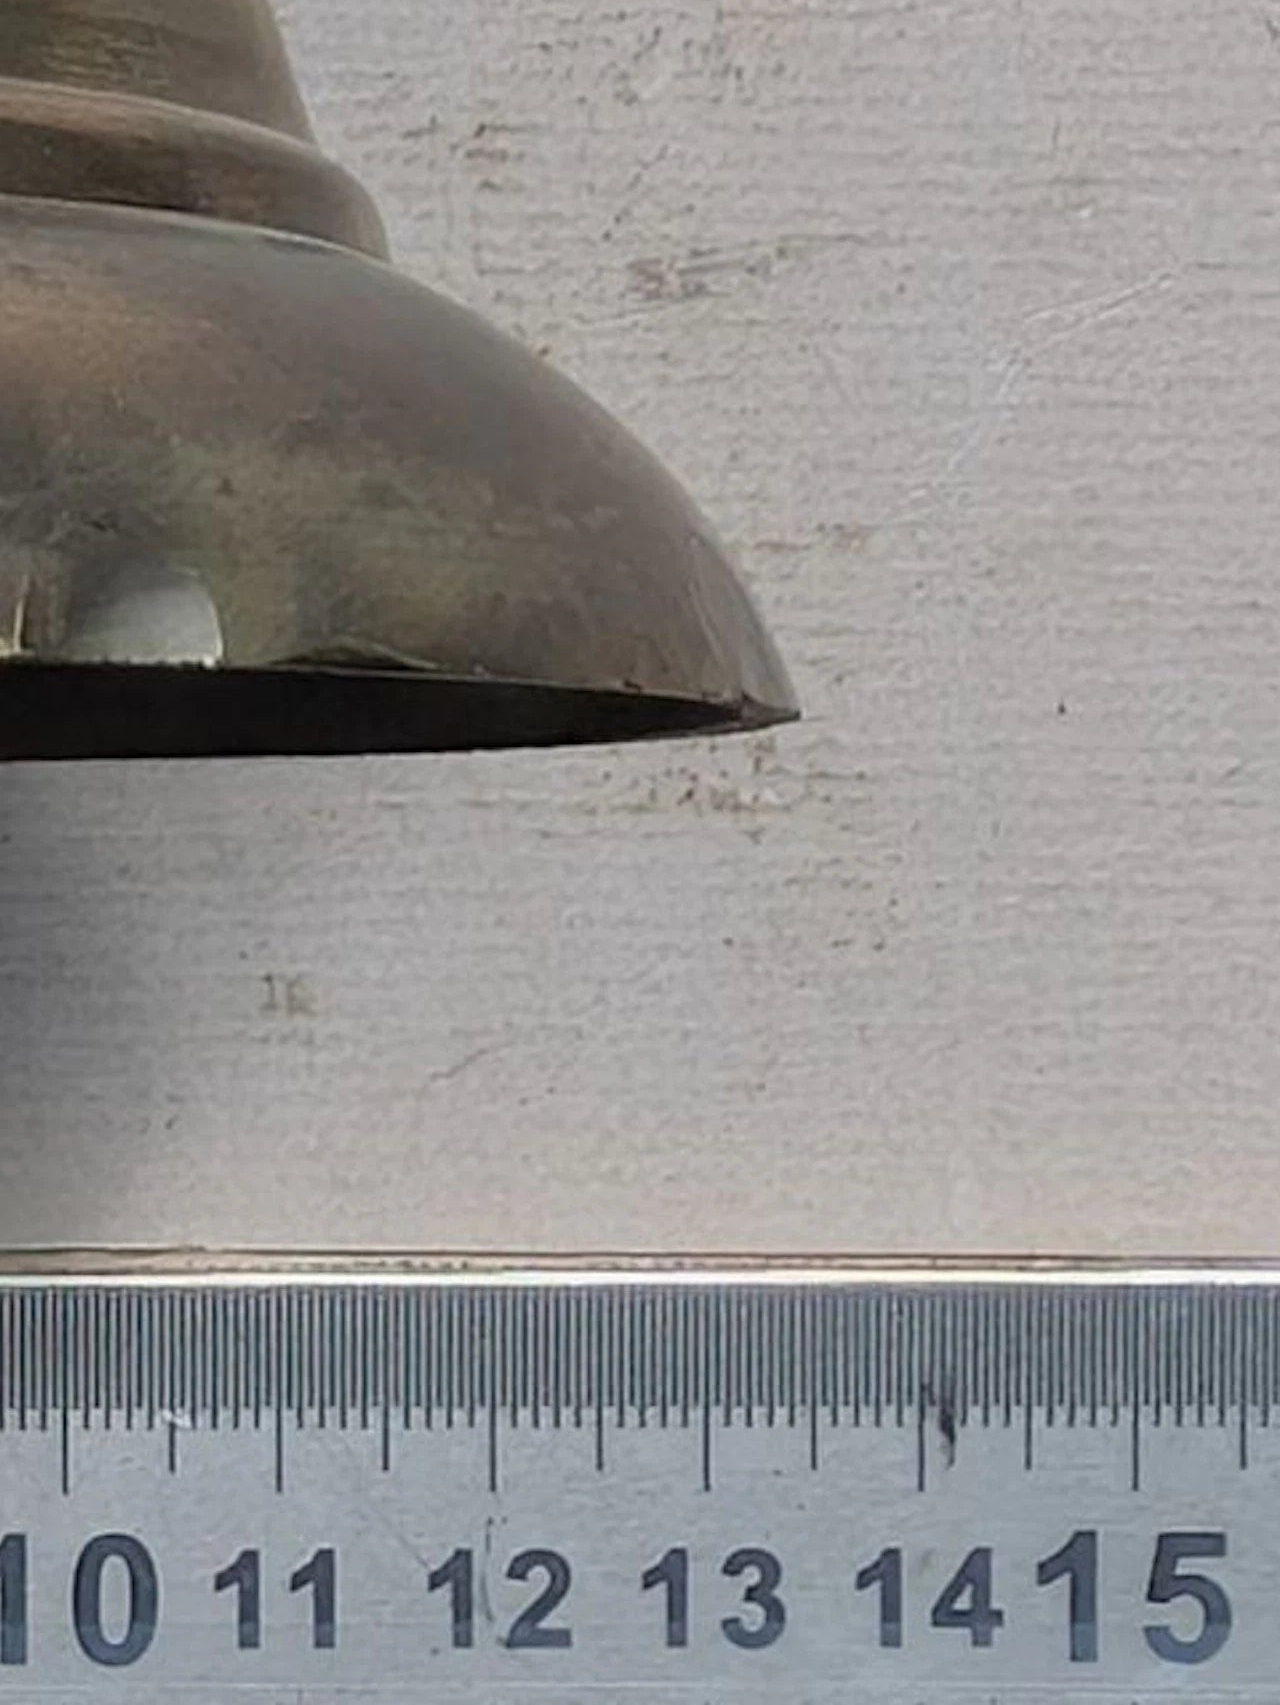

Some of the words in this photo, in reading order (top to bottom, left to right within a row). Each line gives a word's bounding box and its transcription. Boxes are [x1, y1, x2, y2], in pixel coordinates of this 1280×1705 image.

[213, 1548, 336, 1649] 11
[427, 1547, 573, 1649] 12
[640, 1547, 786, 1649] 13
[854, 1547, 1004, 1649] 14
[1036, 1529, 1232, 1663] 15
